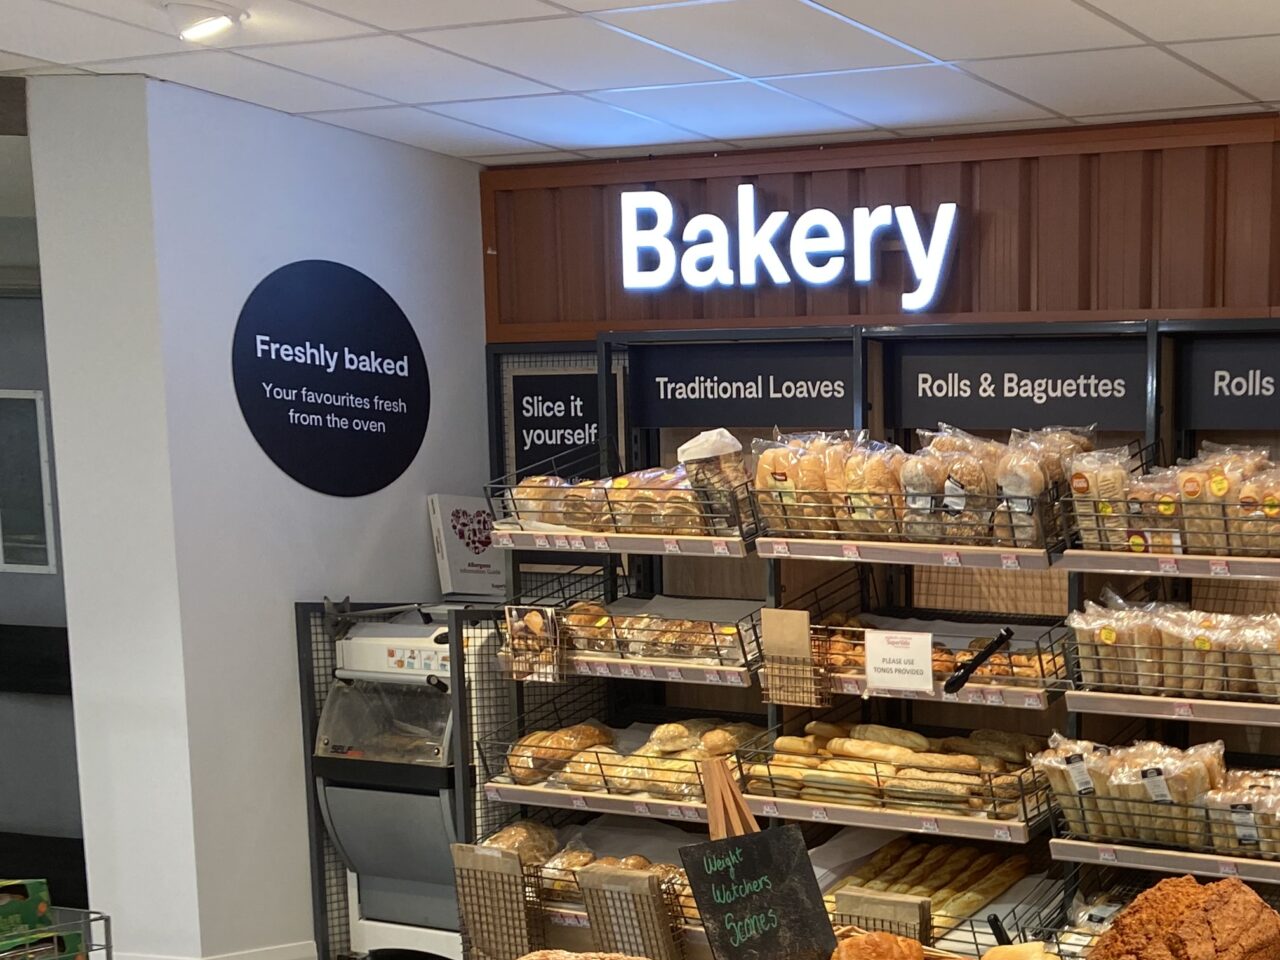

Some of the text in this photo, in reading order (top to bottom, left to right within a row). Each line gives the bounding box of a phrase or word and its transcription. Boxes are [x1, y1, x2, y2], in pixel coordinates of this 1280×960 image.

[621, 184, 957, 312] Bakery
[255, 335, 409, 377] Freshly baked
[655, 375, 845, 400] Traditional Loaves
[917, 373, 1126, 405] Rolls & Baguettes
[1213, 370, 1275, 396] Rolls
[262, 382, 407, 413] Your favourites fresh
[522, 395, 583, 417] Slice it
[288, 409, 386, 433] from the oven
[522, 423, 598, 450] yourself
[873, 666, 924, 676] TONGS PROVIDED
[881, 657, 915, 666] PLEASE USE
[703, 847, 743, 880] Weight
[712, 875, 772, 904] Watchers
[724, 909, 777, 947] Scones
